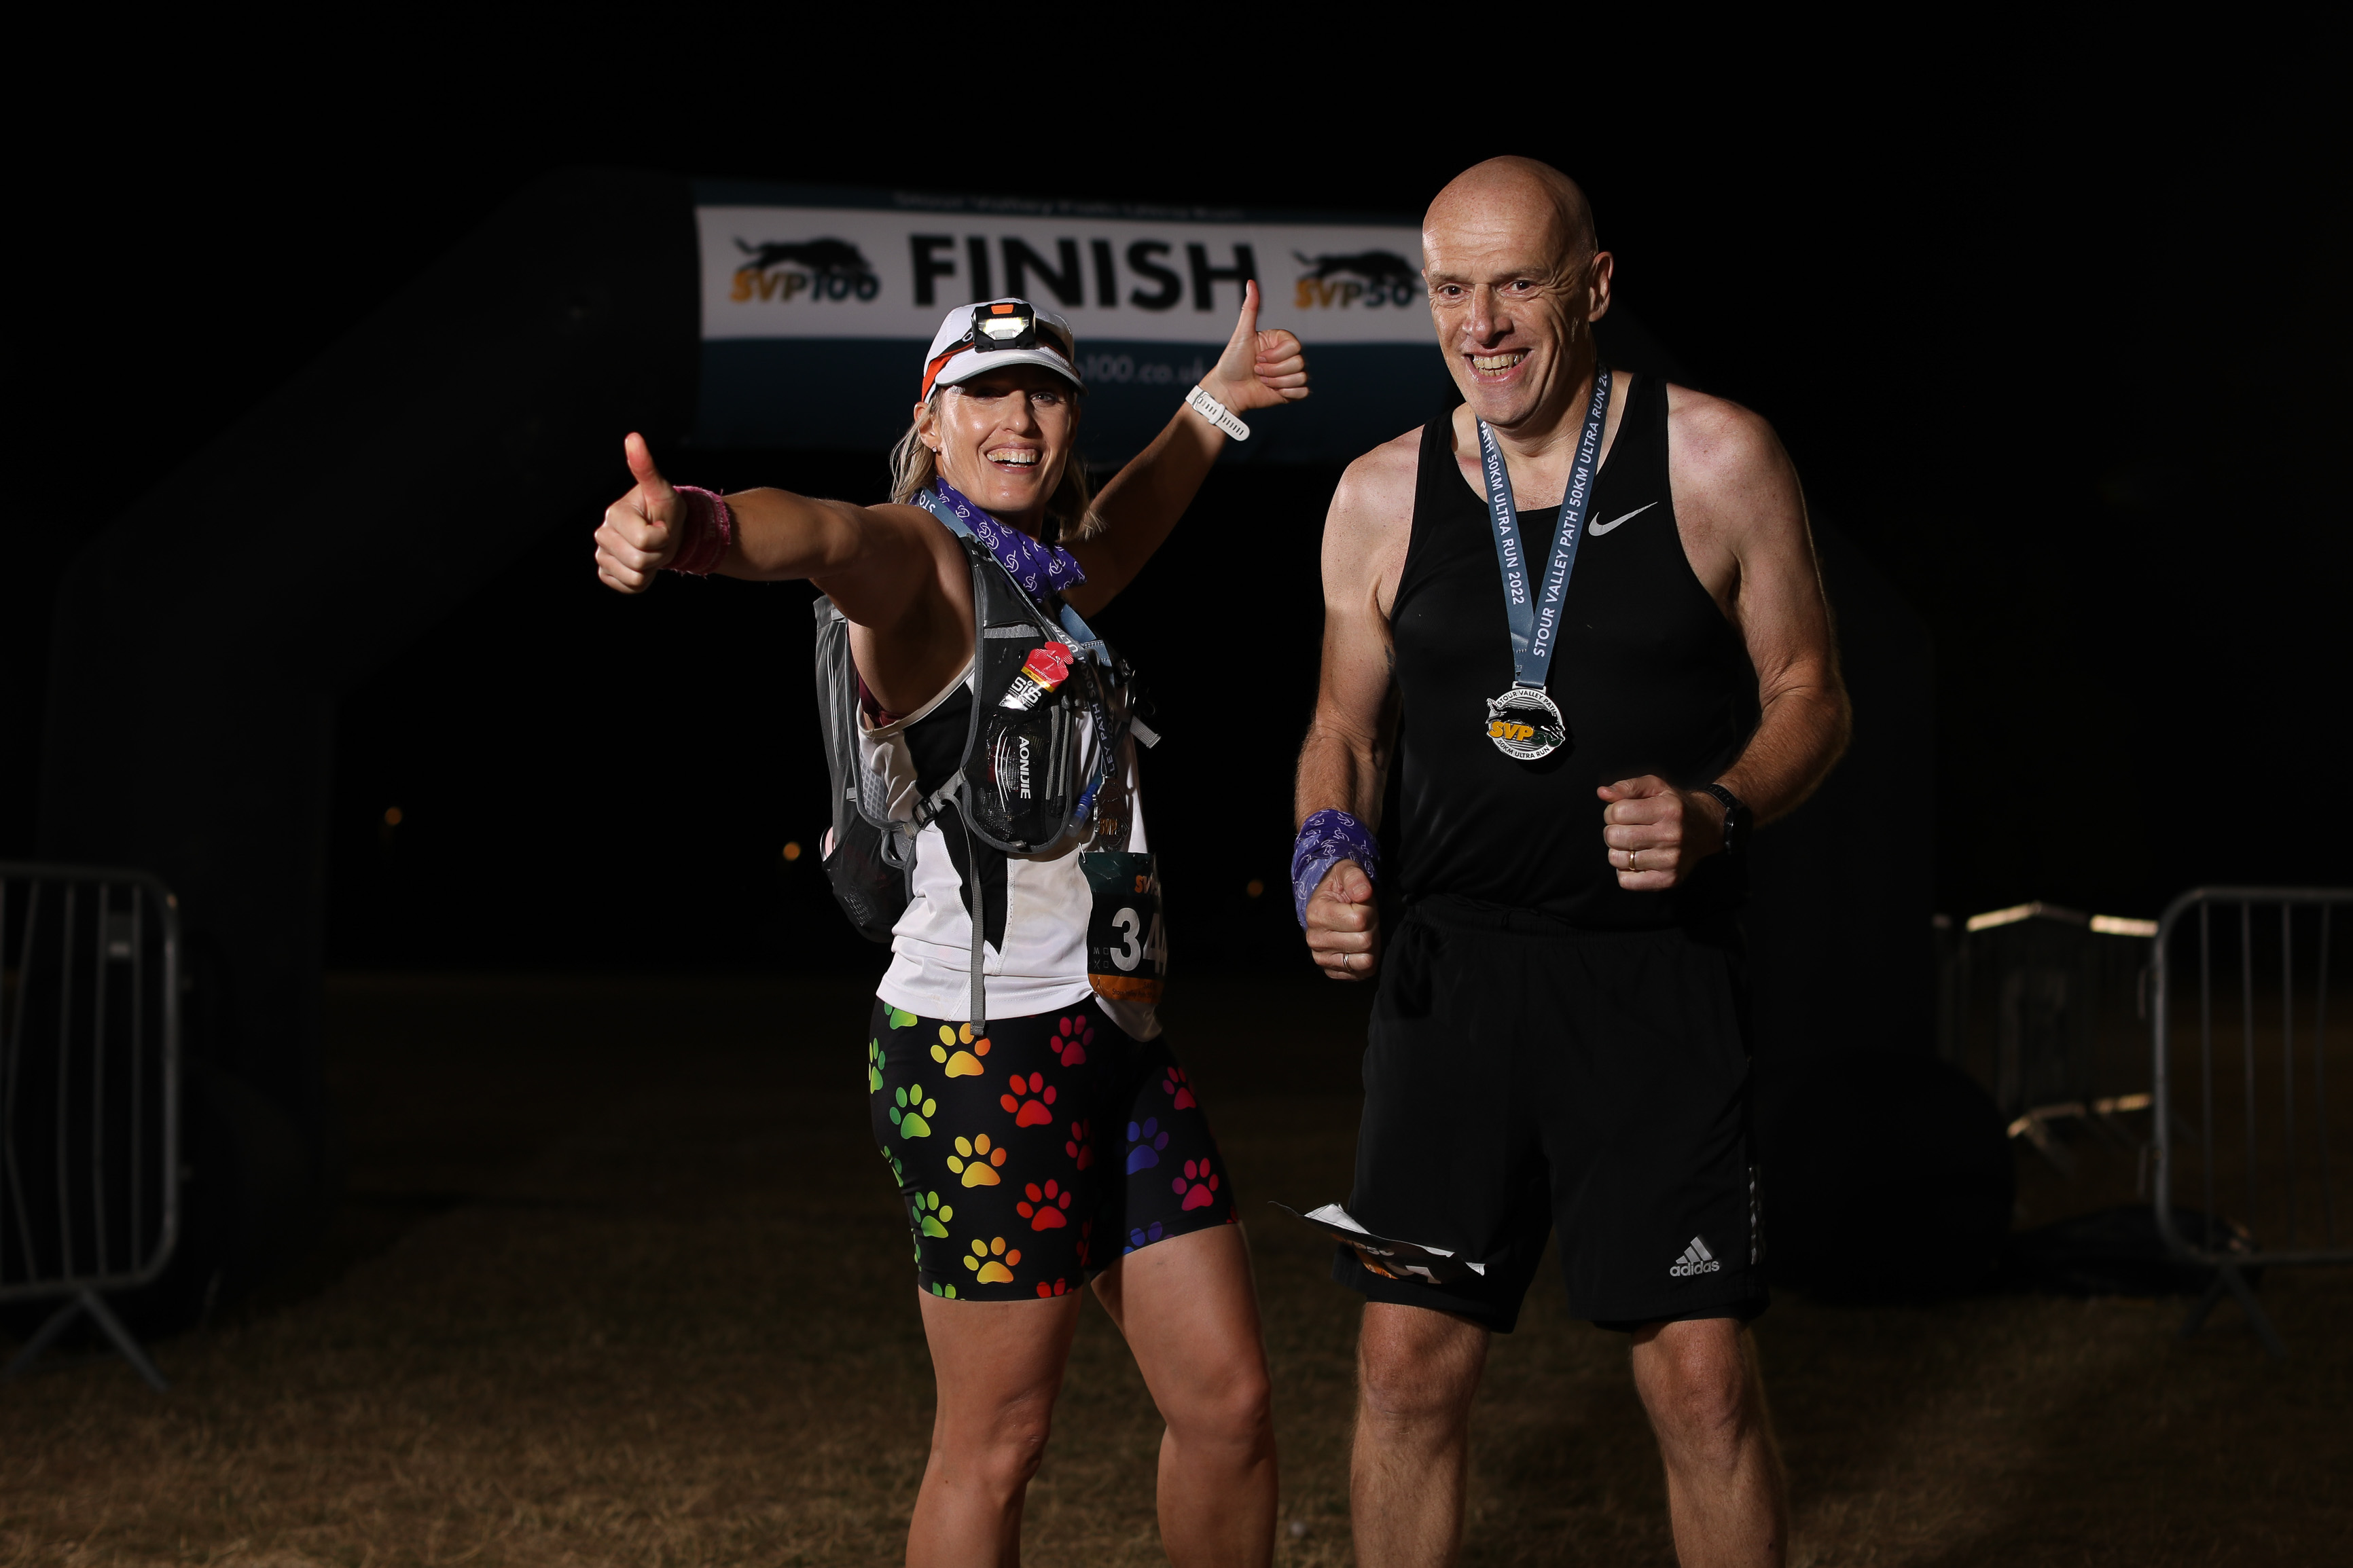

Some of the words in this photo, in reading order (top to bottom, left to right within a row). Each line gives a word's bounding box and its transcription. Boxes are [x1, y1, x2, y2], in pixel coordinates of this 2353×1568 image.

[731, 270, 878, 302] SVP100
[910, 234, 1259, 311] FINISH
[1296, 278, 1414, 308] SVP50
[1592, 388, 1605, 418] RUN
[1480, 421, 1494, 454] PATH
[1579, 422, 1599, 464] ULTRA
[1487, 453, 1503, 491] 50KM
[1569, 467, 1589, 507] 50KM
[1494, 492, 1511, 536] ULTRA
[1560, 510, 1579, 547] PATH
[1502, 538, 1518, 568] RUN
[1508, 571, 1525, 604] 2022
[1545, 549, 1568, 603] VALLEY
[1533, 607, 1555, 657] STOUR
[1497, 691, 1517, 706] STOUR
[1519, 691, 1543, 699] VALLEY
[1092, 703, 1106, 741] PATH
[1496, 739, 1514, 755] 50KM
[1536, 746, 1551, 756] RUN
[1019, 735, 1031, 799] AONIJIE
[1670, 1260, 1720, 1277] adidas
